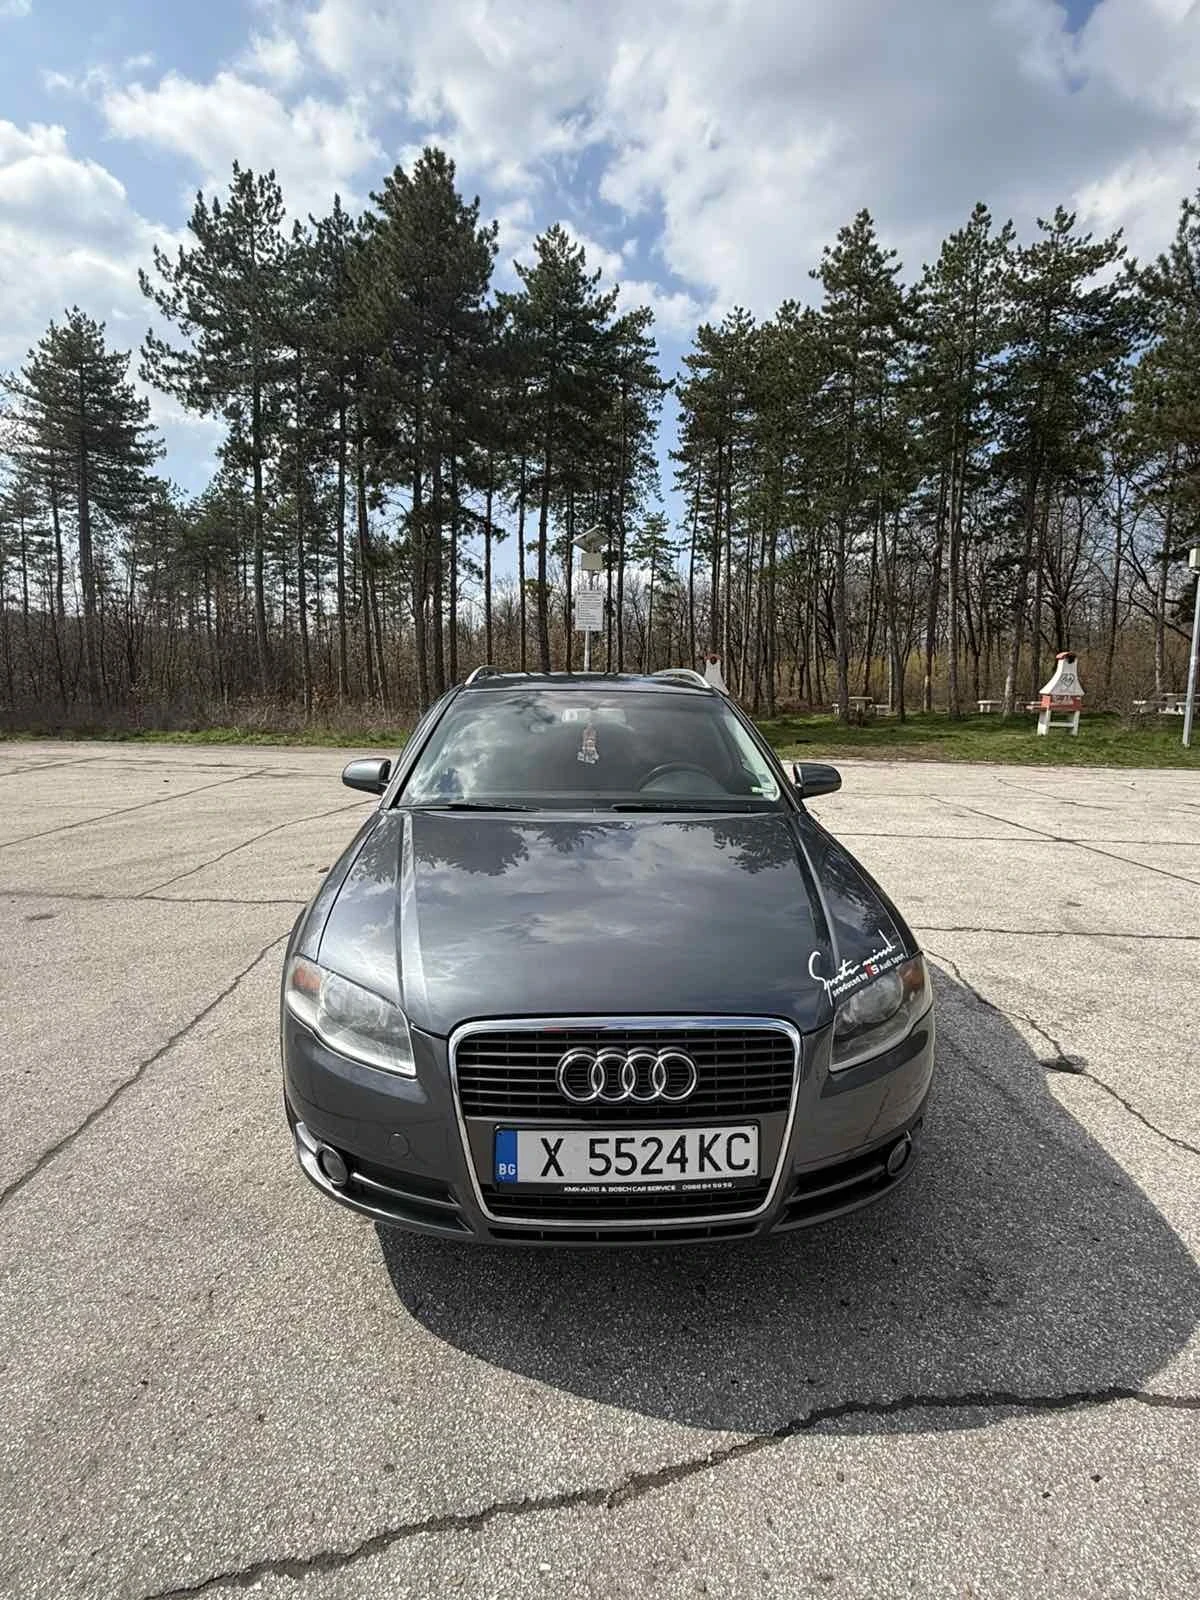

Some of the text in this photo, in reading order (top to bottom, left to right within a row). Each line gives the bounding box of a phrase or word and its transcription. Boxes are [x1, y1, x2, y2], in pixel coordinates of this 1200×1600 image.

[862, 929, 896, 966] mind
[832, 975, 861, 997] produced
[540, 1132, 751, 1177] X 5524 KC
[498, 1163, 516, 1176] BG
[647, 1184, 676, 1192] SERVICE
